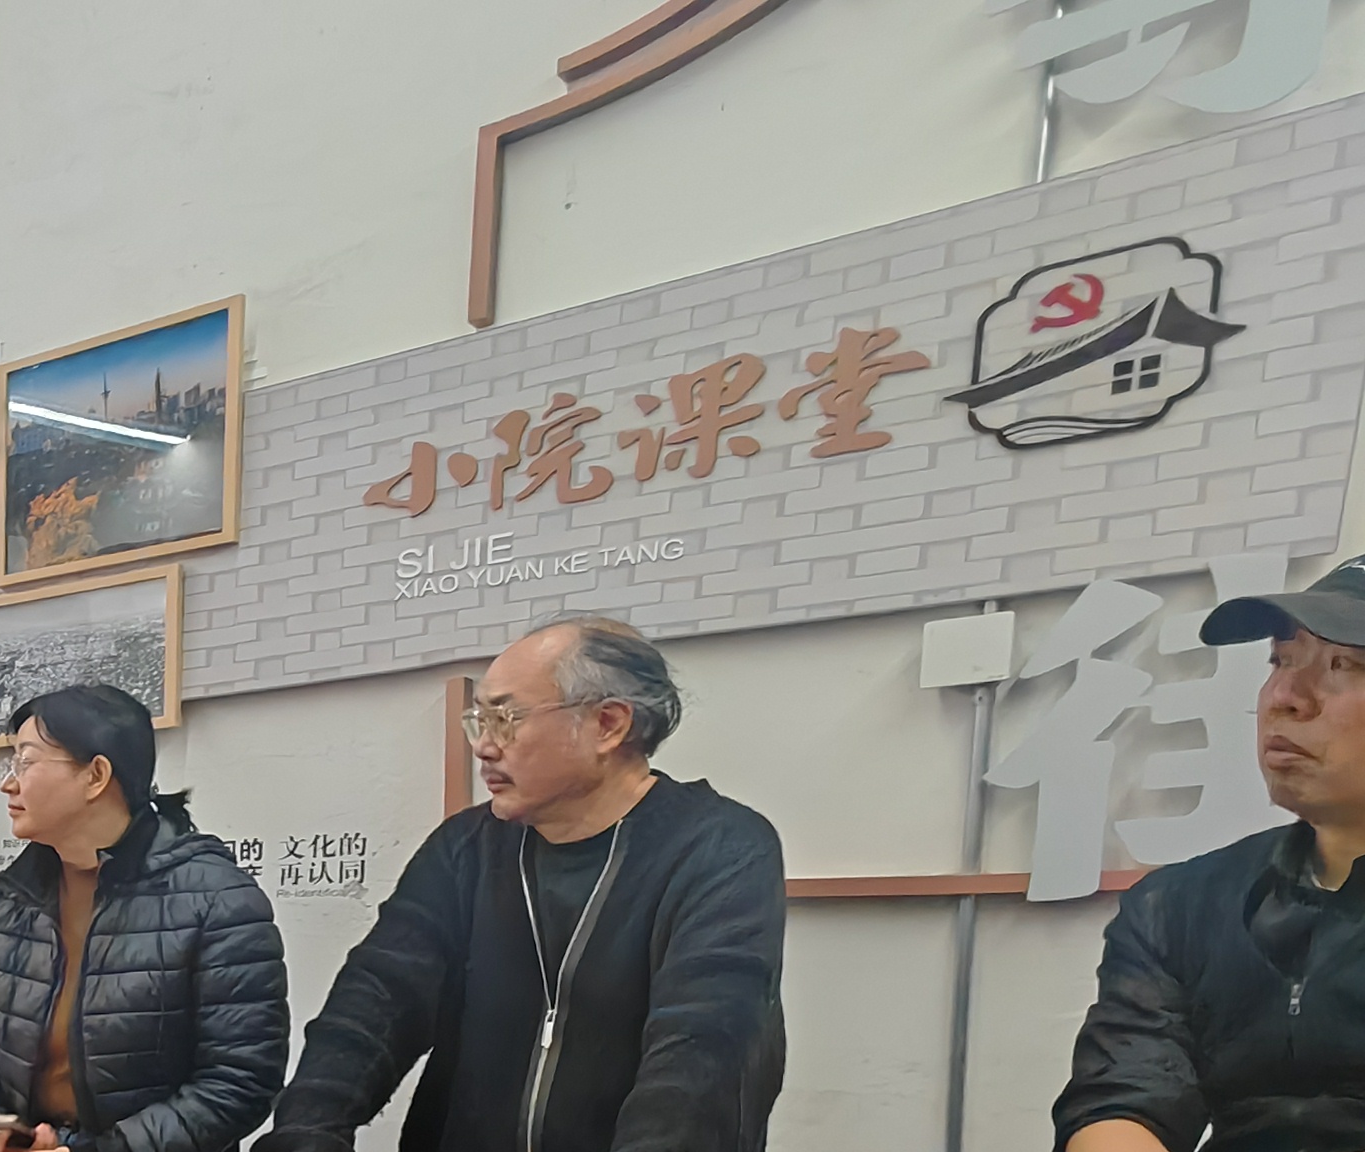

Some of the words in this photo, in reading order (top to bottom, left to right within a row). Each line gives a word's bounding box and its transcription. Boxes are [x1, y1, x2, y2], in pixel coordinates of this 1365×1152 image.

[364, 326, 932, 518] 小院课堂
[394, 574, 459, 601] XIAO
[467, 559, 544, 589] YUAN
[554, 552, 589, 576] KE
[598, 537, 685, 568] TANG
[395, 545, 435, 580] SI
[450, 531, 515, 572] JIE
[278, 832, 367, 860] 文化的
[279, 860, 366, 886] 再认同
